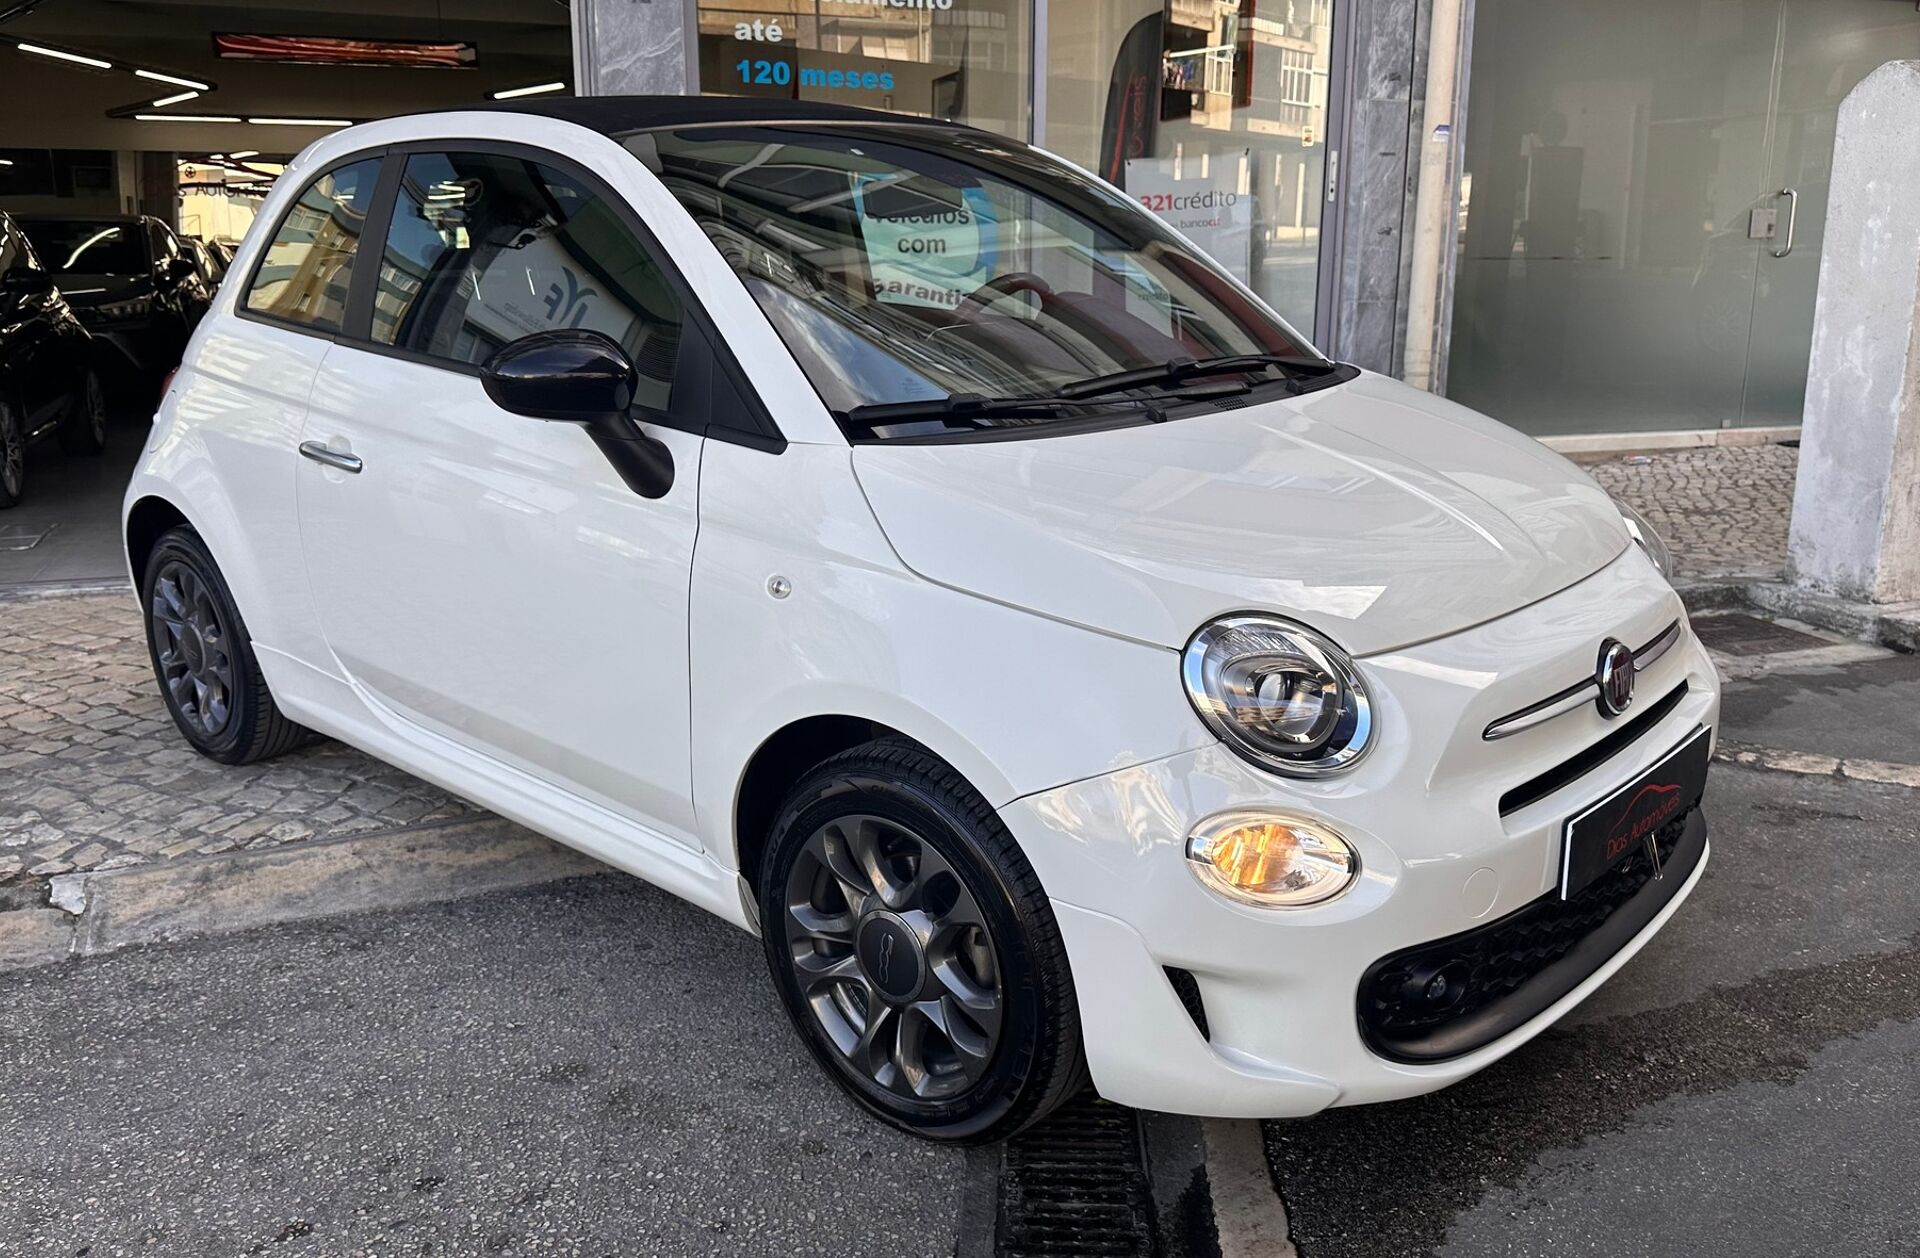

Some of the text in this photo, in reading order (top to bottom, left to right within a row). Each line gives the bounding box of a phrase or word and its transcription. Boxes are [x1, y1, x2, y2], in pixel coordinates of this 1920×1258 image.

[734, 18, 783, 42] até
[736, 59, 895, 90] 120 meses
[897, 238, 947, 254] com
[1612, 661, 1631, 700] FIAT
[1606, 832, 1629, 861] Dias
